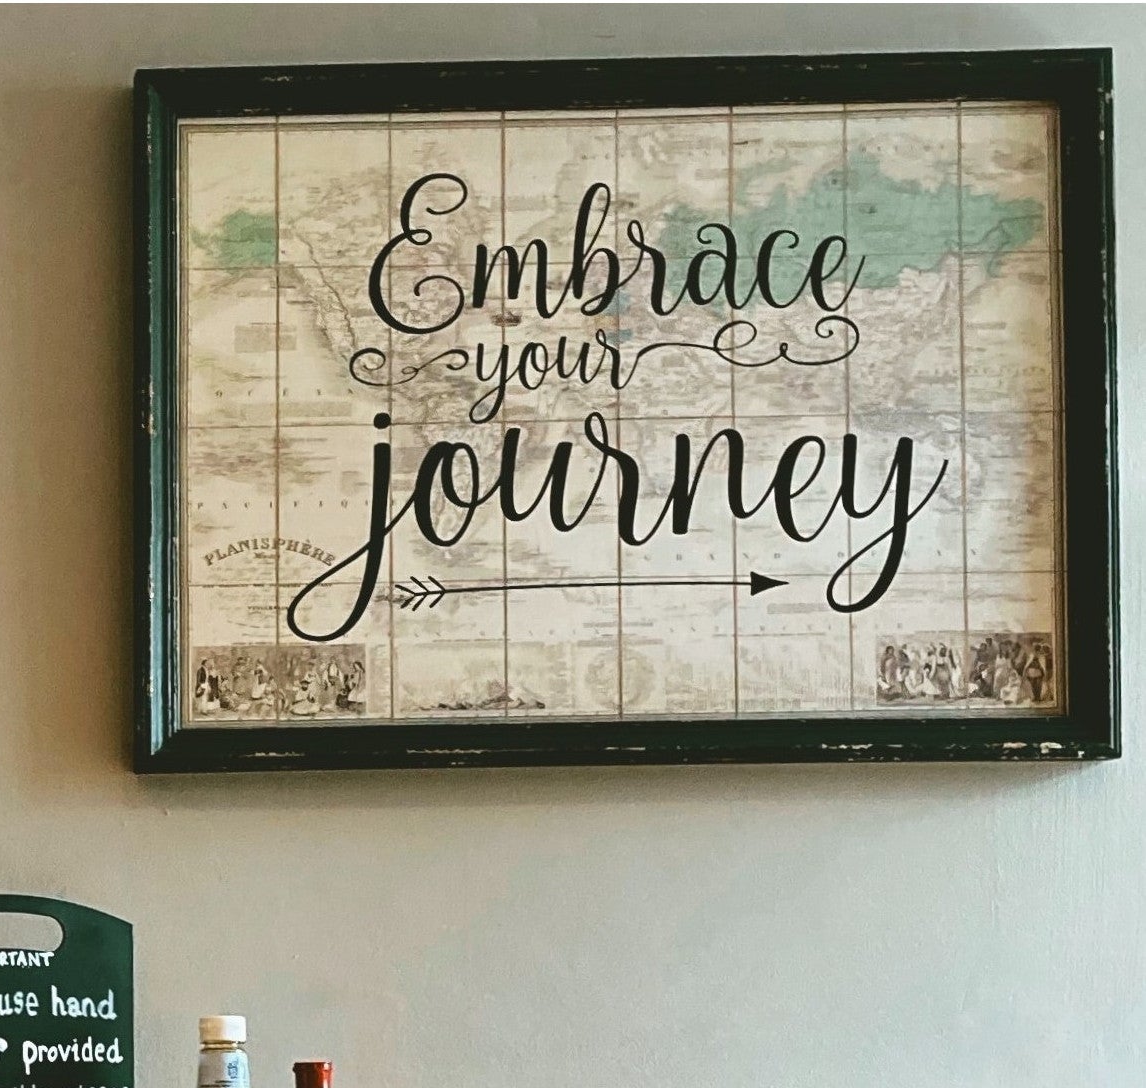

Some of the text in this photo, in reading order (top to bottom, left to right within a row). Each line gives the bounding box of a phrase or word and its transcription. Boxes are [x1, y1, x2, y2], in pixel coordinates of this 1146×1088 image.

[368, 172, 867, 335] Embrace
[468, 328, 644, 424] your
[286, 411, 949, 642] journey
[51, 984, 117, 1020] hand
[22, 1035, 124, 1075] provided
